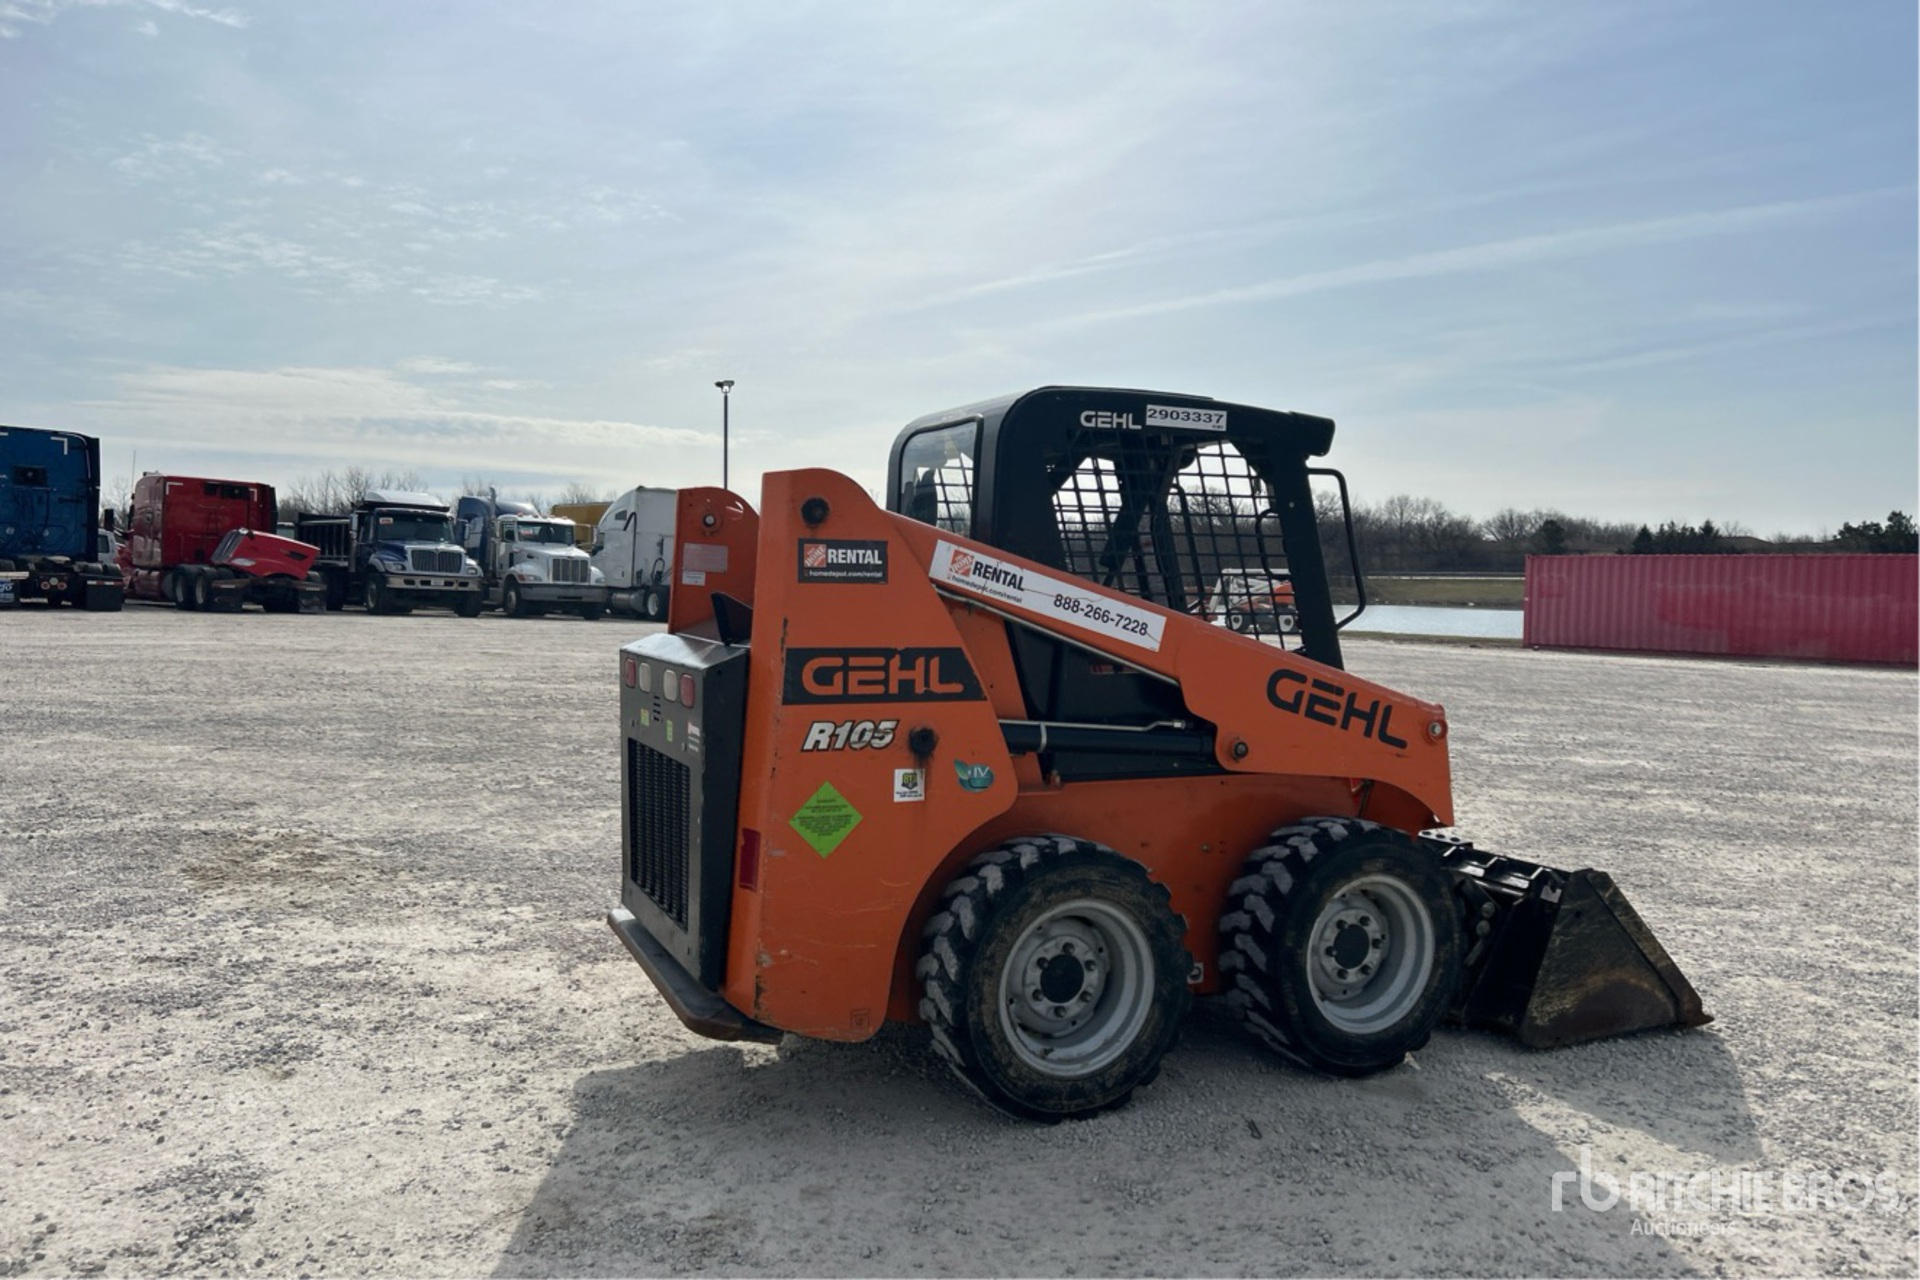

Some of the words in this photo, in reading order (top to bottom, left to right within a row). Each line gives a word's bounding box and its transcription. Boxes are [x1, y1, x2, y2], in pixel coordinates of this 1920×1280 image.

[1080, 410, 1142, 430] GEHL
[1147, 408, 1224, 424] 2903337
[827, 549, 883, 565] RENTAL
[809, 570, 883, 578] homedepot.com/rental
[972, 561, 1024, 591] RENTAL
[1053, 593, 1148, 636] 888-266-7228
[802, 654, 964, 696] GEHL
[1267, 668, 1407, 749] GEHL
[801, 720, 899, 752] R105
